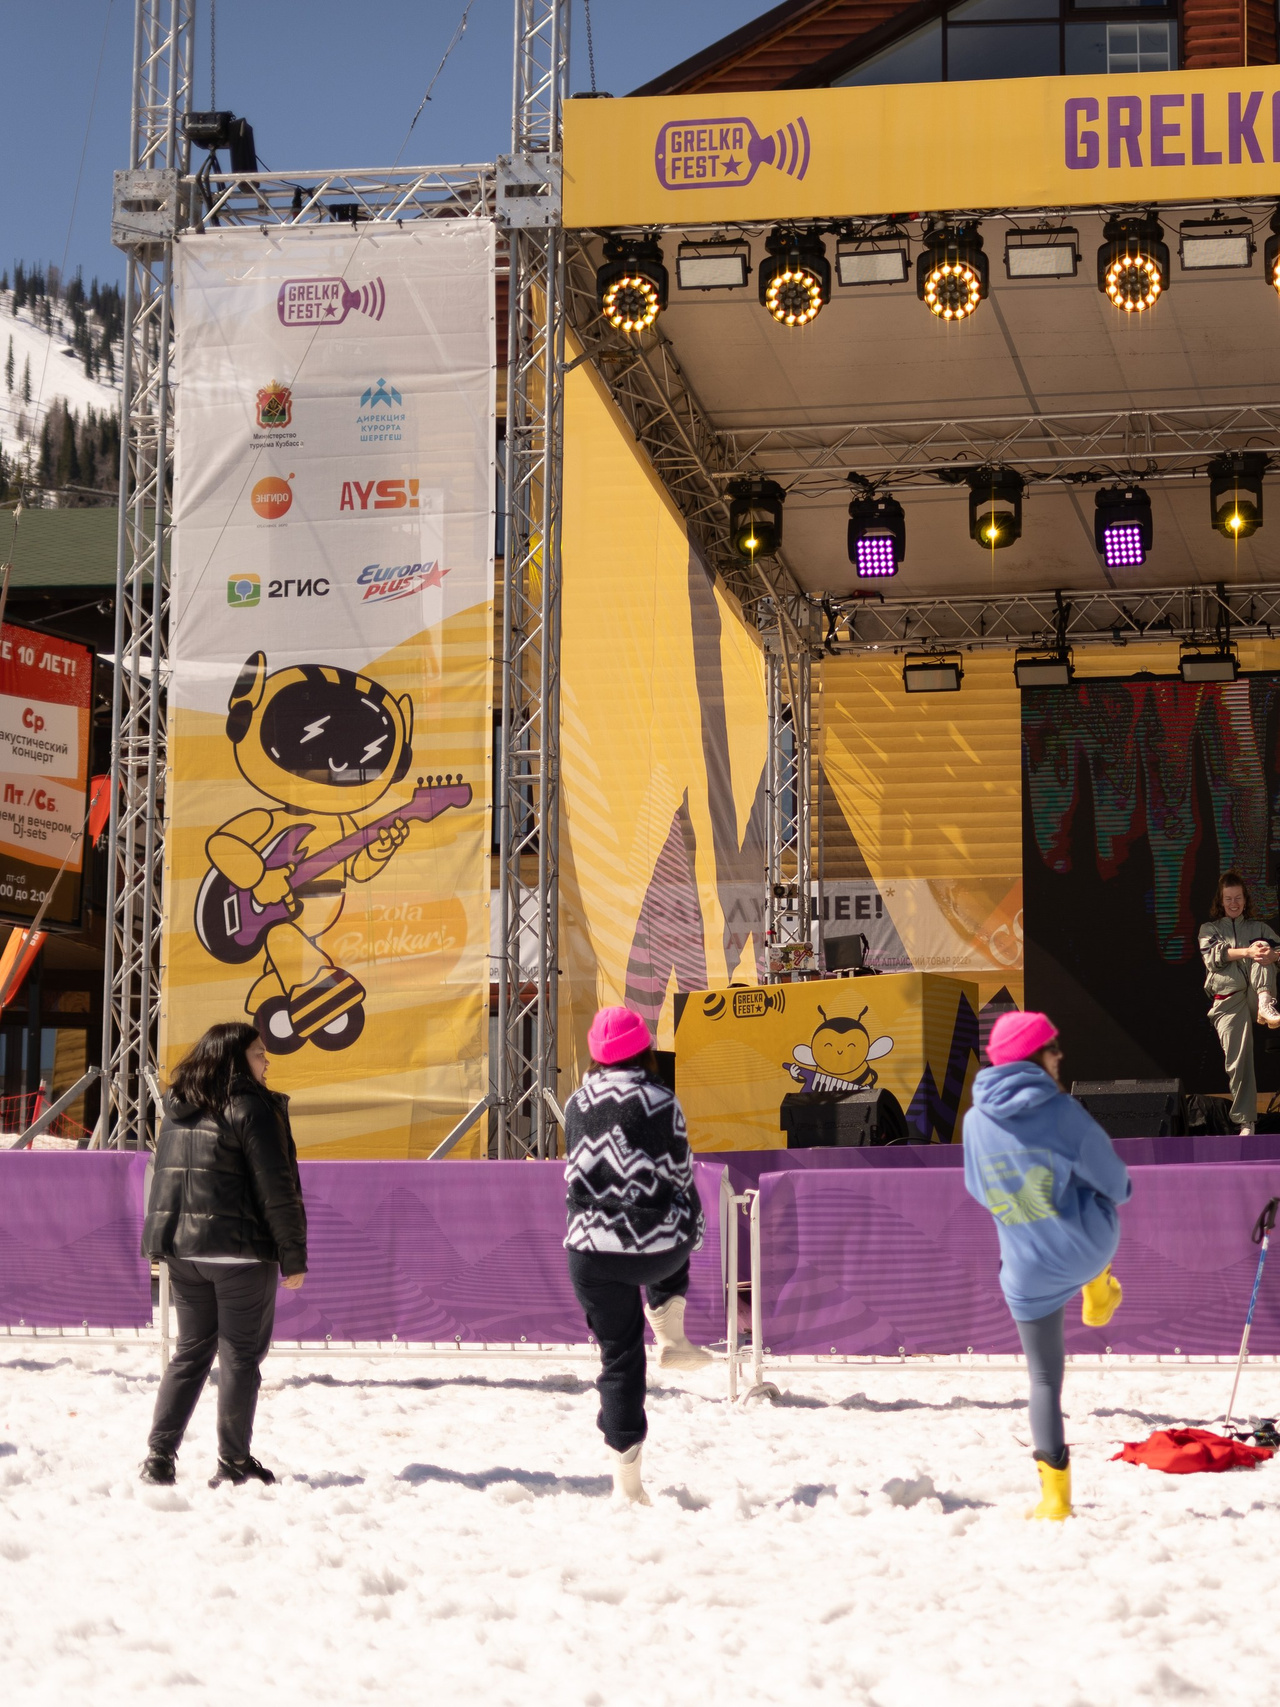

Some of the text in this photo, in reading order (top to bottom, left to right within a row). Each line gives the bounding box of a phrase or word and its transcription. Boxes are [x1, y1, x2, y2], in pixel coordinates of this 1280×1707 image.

[670, 127, 744, 153] GRELKA
[670, 153, 719, 180] FEST
[288, 284, 340, 301] GRELKA
[288, 303, 322, 320] FEST
[356, 414, 406, 424] ДИРЕКЦИЯ
[253, 432, 297, 441] Министерство
[361, 424, 401, 432] КУРОРТА
[249, 440, 305, 450] туризма Кузбасса
[360, 434, 402, 442] ШЕРЕГЕШ
[255, 493, 289, 505] энгиро
[339, 478, 420, 511] AYS!
[267, 577, 330, 599] 2ГИС
[17, 646, 35, 667] 10
[38, 652, 77, 678] ЛЕТ!
[22, 707, 47, 734] Ср.
[0, 730, 68, 755] акустический
[12, 745, 54, 764] концерт
[13, 822, 47, 841] Dj-sets
[18, 814, 25, 824] и
[27, 816, 73, 833] вечером
[14, 889, 28, 901] до
[926, 955, 951, 966] ТОВАР
[737, 994, 763, 1005] GRELKA
[738, 1004, 755, 1014] FEST
